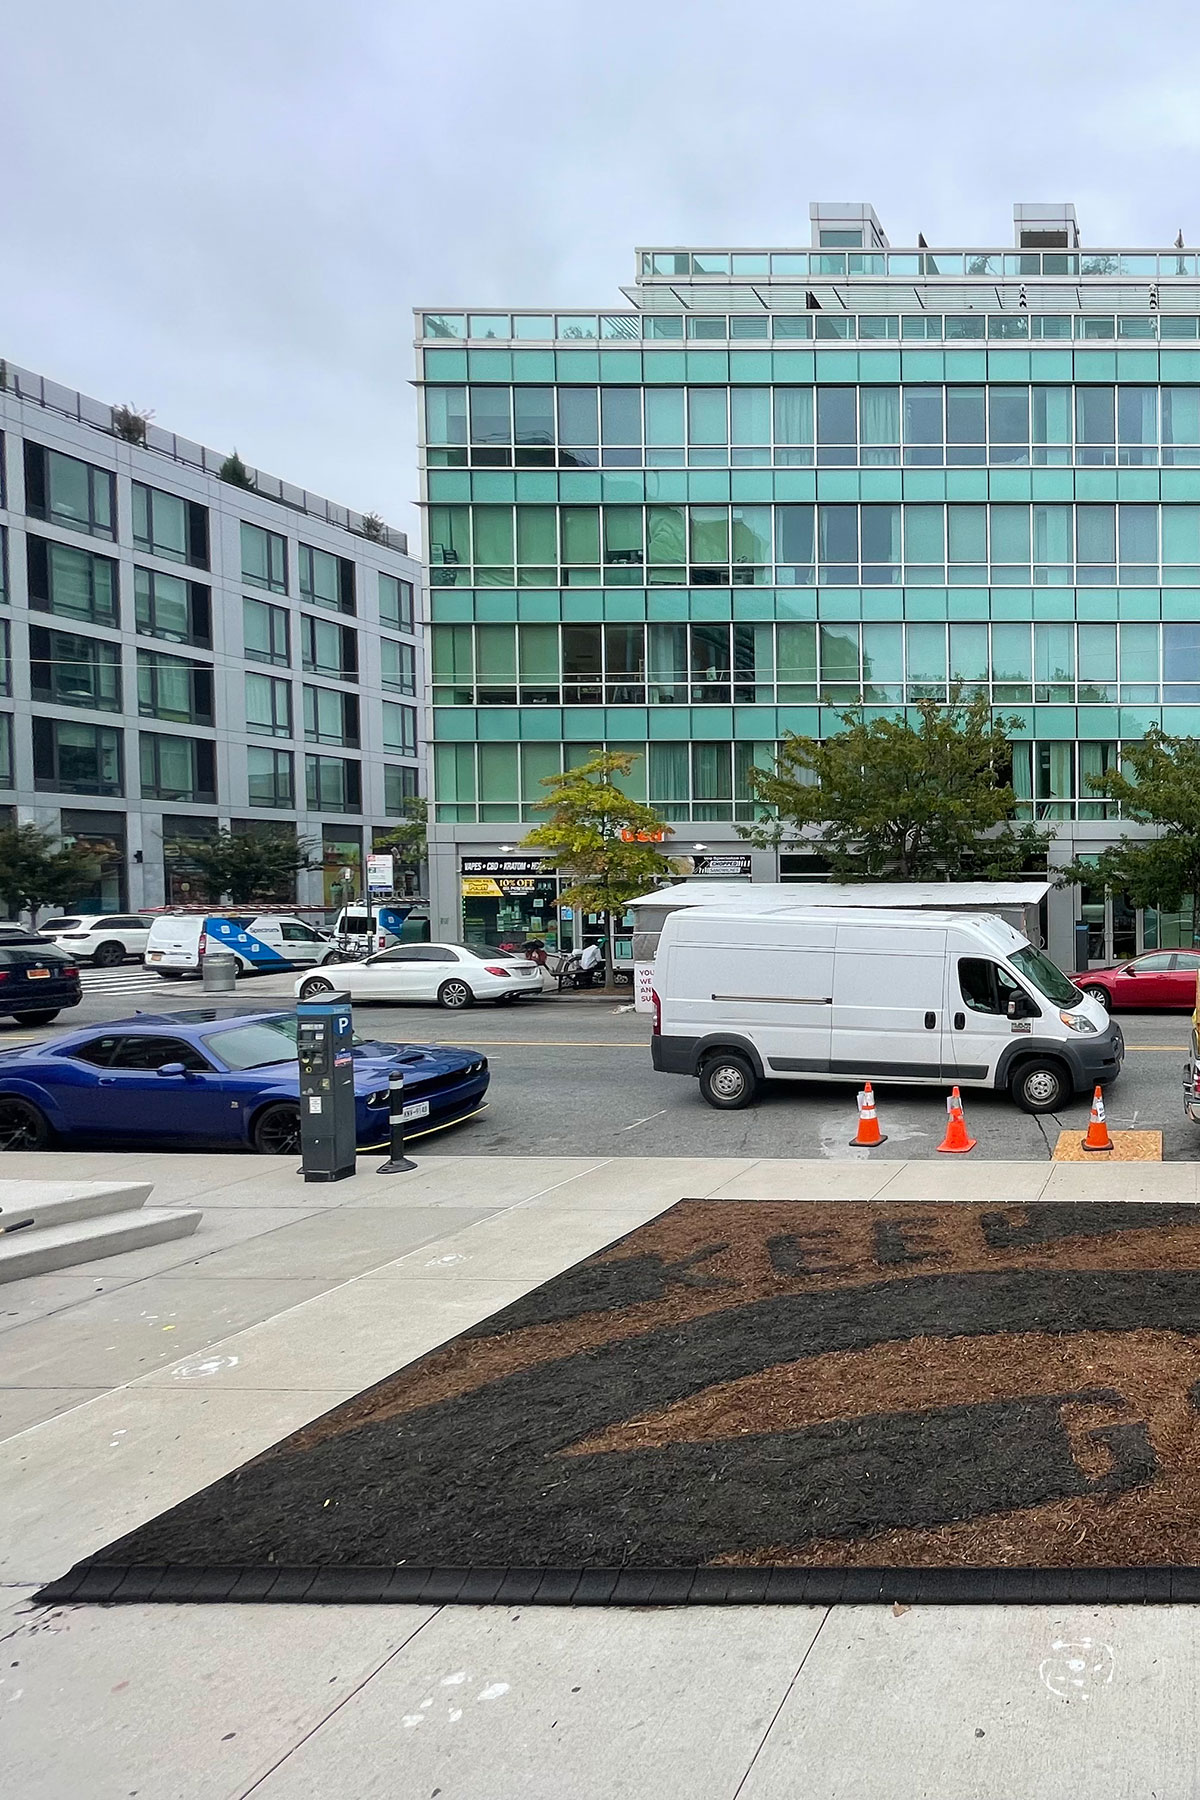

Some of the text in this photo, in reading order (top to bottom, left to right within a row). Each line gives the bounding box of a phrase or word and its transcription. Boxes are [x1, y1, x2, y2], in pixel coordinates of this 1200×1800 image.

[464, 862, 482, 871] VAPES
[503, 862, 527, 871] KRATOM
[500, 879, 516, 887] 10%
[516, 879, 535, 887] OFF
[338, 1017, 349, 1034] P
